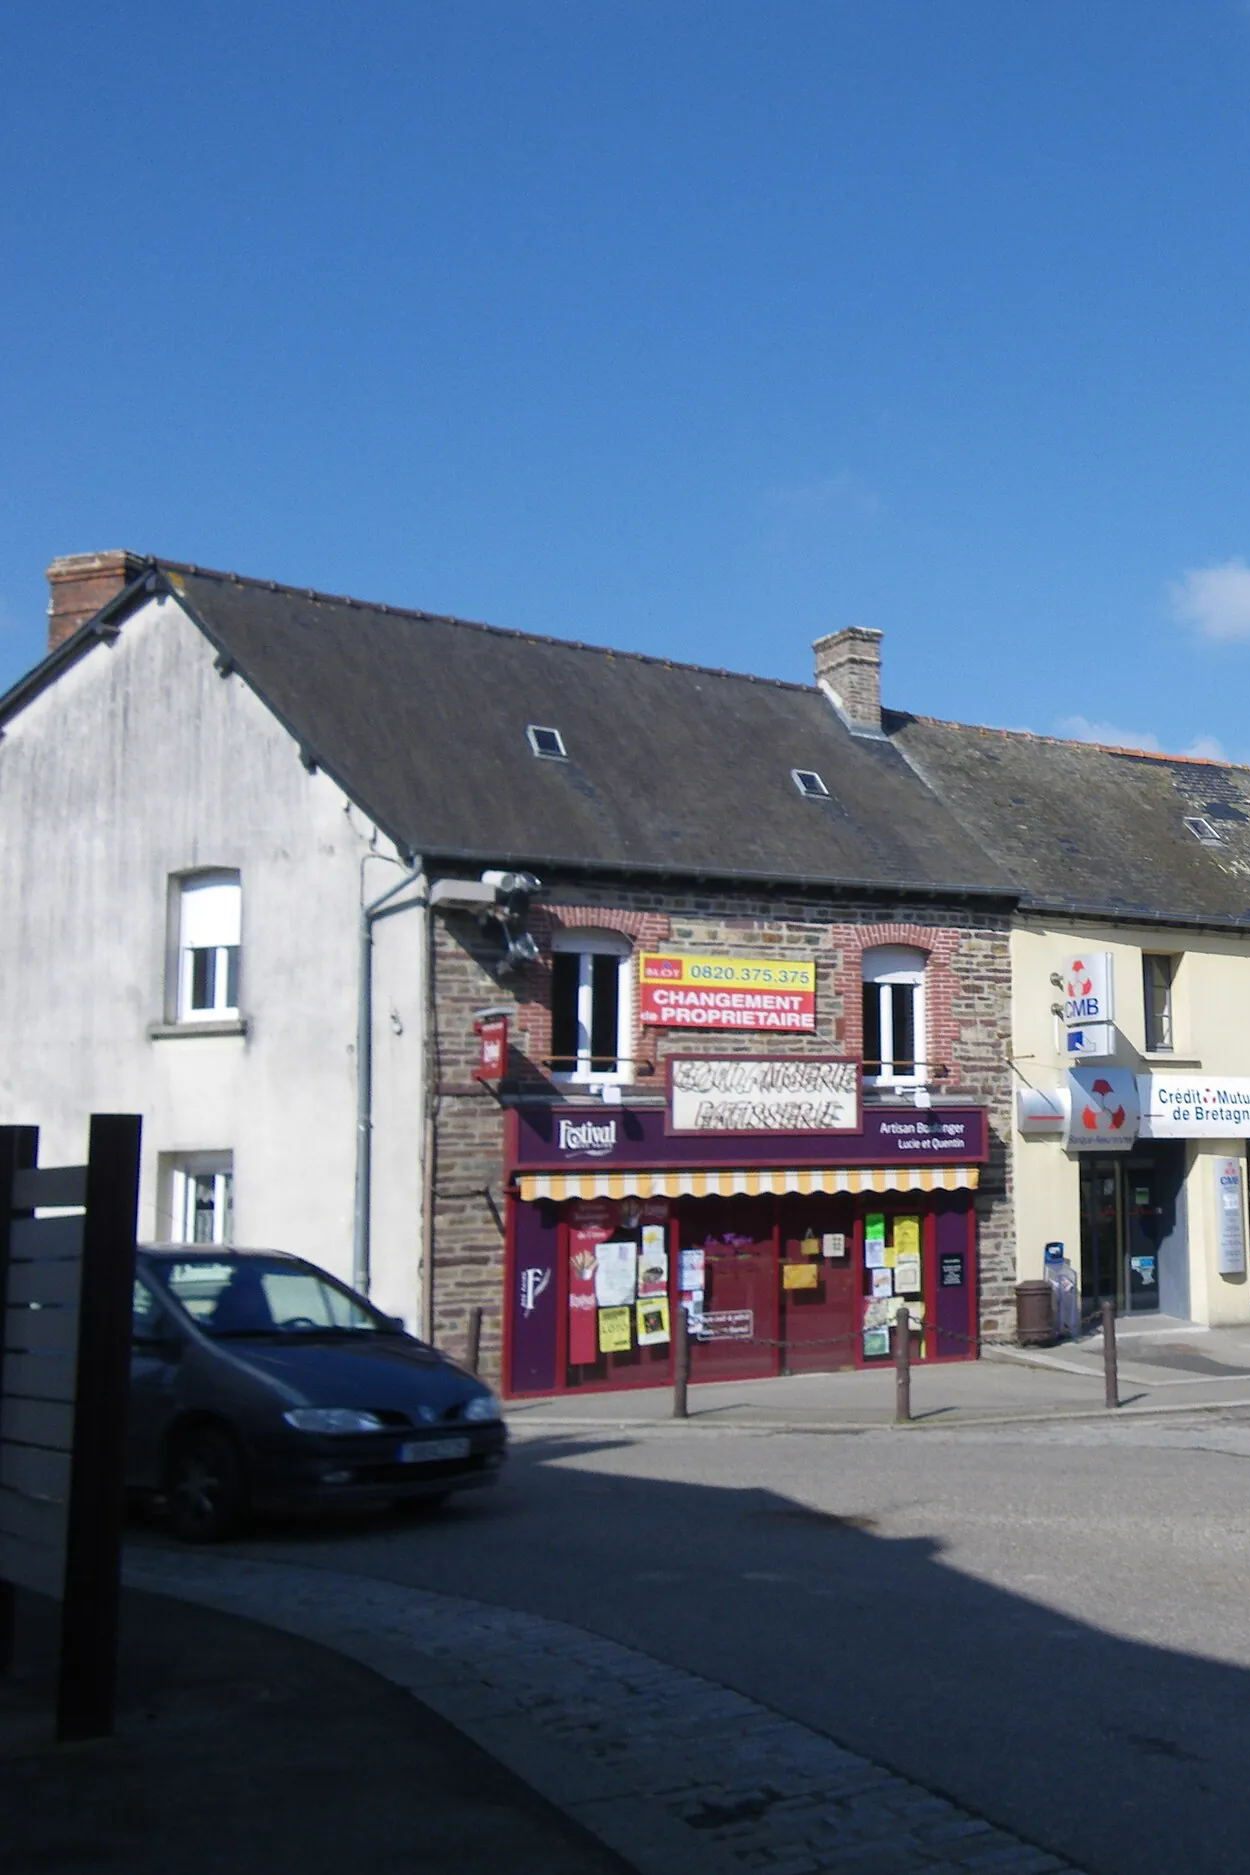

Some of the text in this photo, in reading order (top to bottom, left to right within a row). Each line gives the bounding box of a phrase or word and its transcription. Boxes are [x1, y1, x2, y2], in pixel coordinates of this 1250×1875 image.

[690, 964, 809, 984] 0820.375.375
[652, 988, 803, 1010] CHANGEMENT
[1064, 997, 1099, 1018] CMB
[640, 1007, 815, 1028] de PROPRIETAIRE
[1158, 1087, 1202, 1104] Crédit
[1172, 1106, 1190, 1120] de
[559, 1119, 617, 1149] Festival
[880, 1122, 965, 1136] Artisan Bonger
[897, 1137, 965, 1150] Lucie et Quentin
